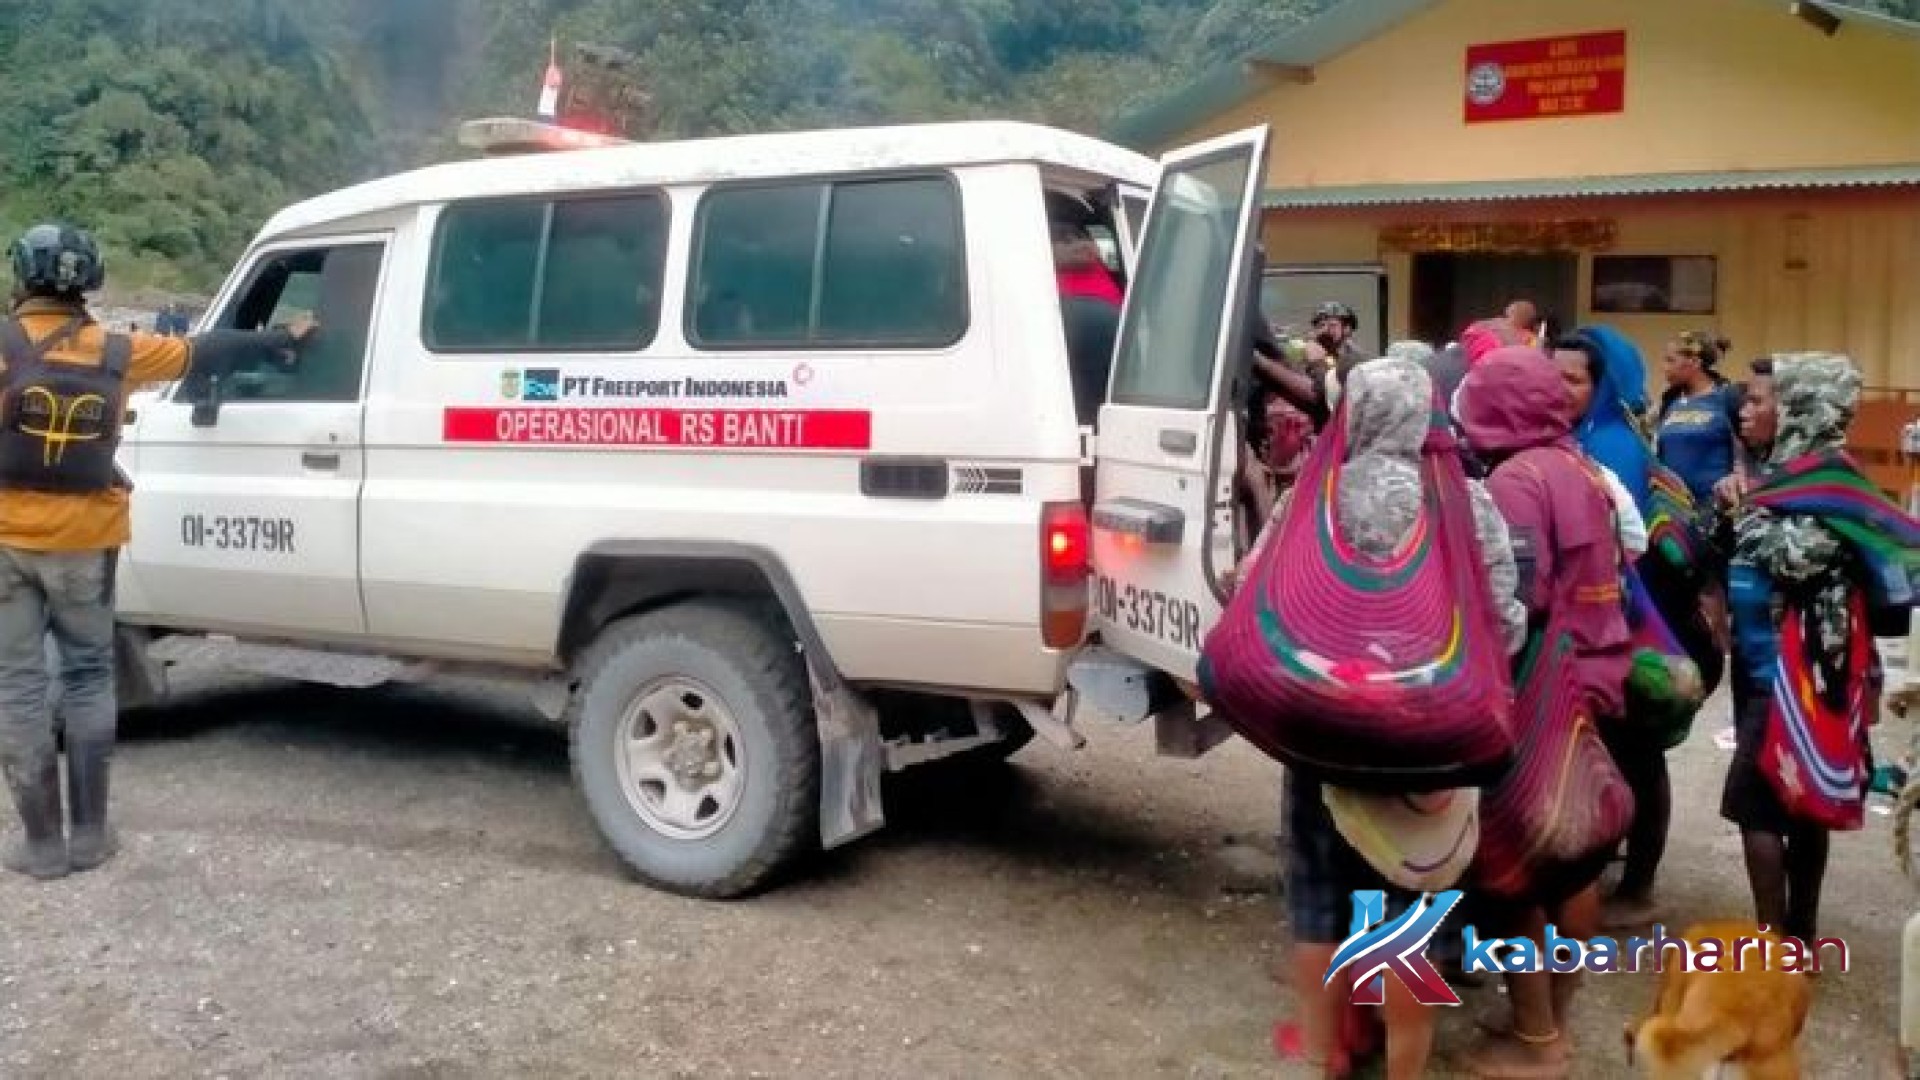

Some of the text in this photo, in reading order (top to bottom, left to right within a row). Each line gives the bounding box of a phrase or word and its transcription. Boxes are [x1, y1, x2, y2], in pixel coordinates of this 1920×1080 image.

[563, 376, 590, 397] PT
[497, 410, 804, 445] OPERASIONAL RS BANTI
